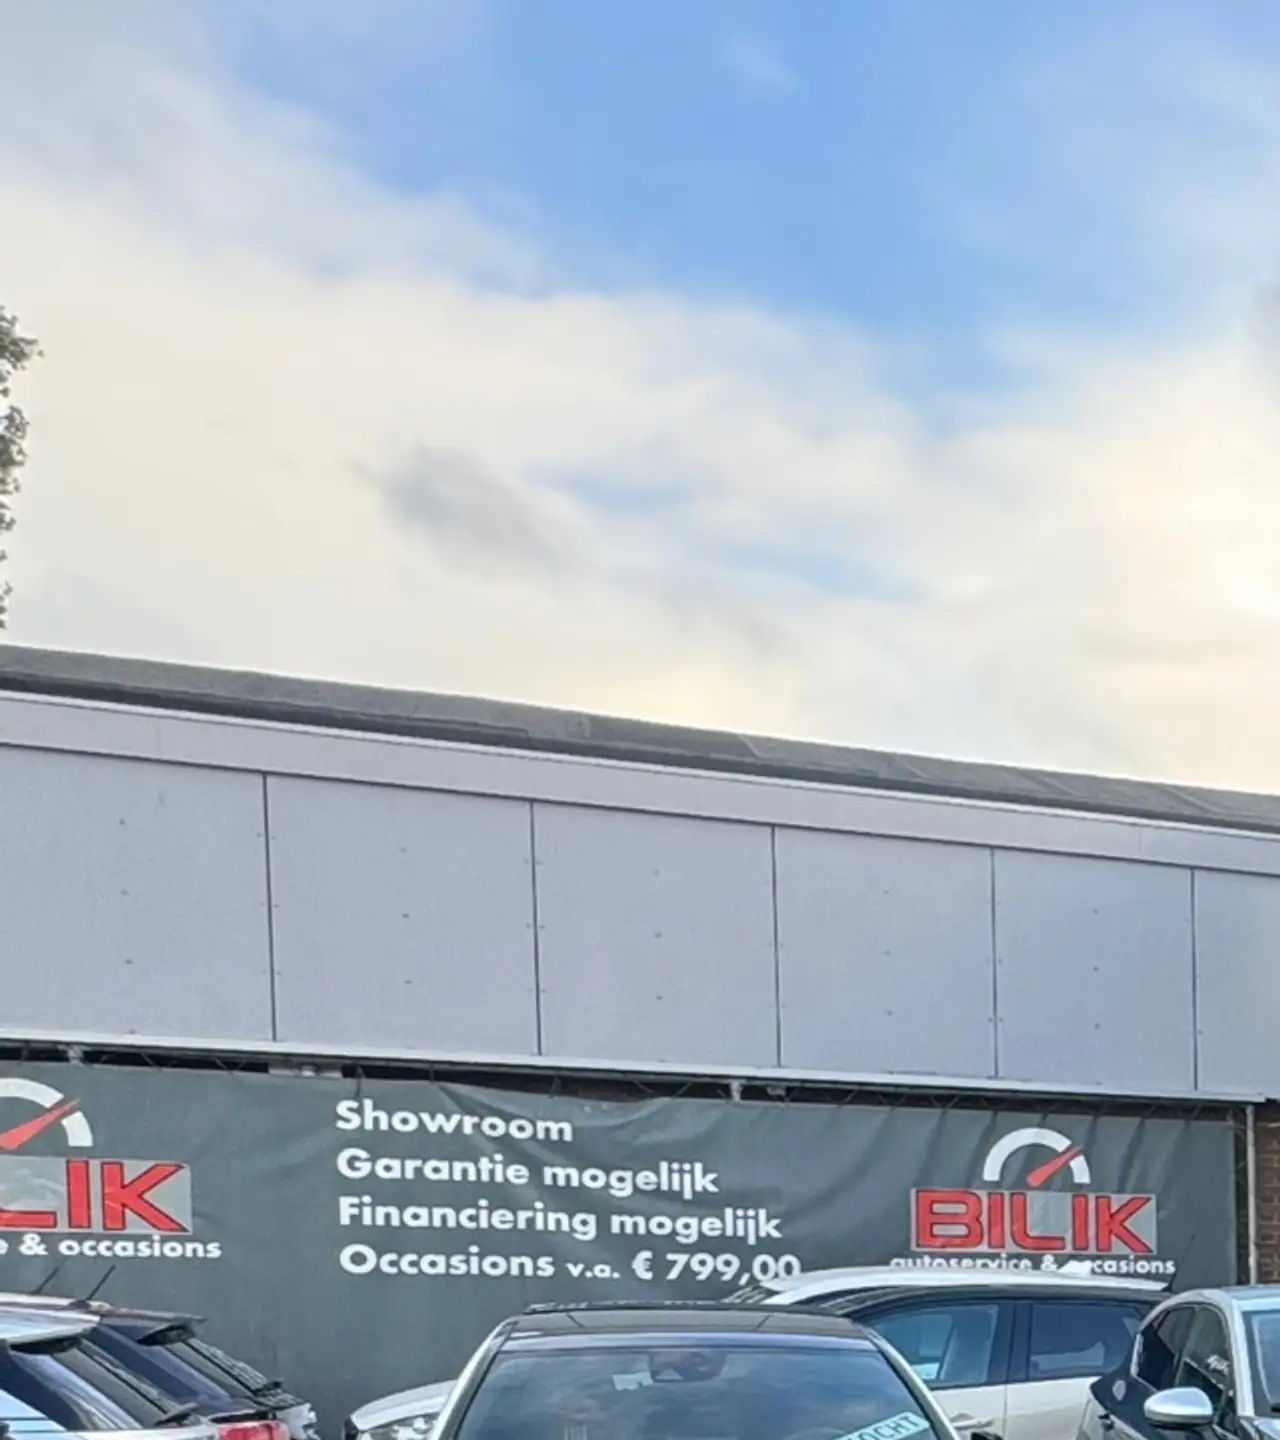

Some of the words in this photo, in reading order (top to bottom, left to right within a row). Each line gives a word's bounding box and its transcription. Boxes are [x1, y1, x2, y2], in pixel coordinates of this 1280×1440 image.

[335, 1099, 573, 1142] Showroom
[336, 1148, 529, 1185] Garantie
[543, 1160, 719, 1199] mogelijk
[339, 1196, 598, 1240] Financiering
[611, 1206, 782, 1245] mogelijk
[916, 1189, 1153, 1253] BILIK
[19, 1233, 48, 1255] &
[58, 1234, 222, 1258] occasions
[340, 1243, 555, 1278] Occasions
[565, 1262, 621, 1279] v.a.
[631, 1250, 653, 1280] €
[666, 1252, 801, 1285] 799,00
[1041, 1254, 1058, 1272] &
